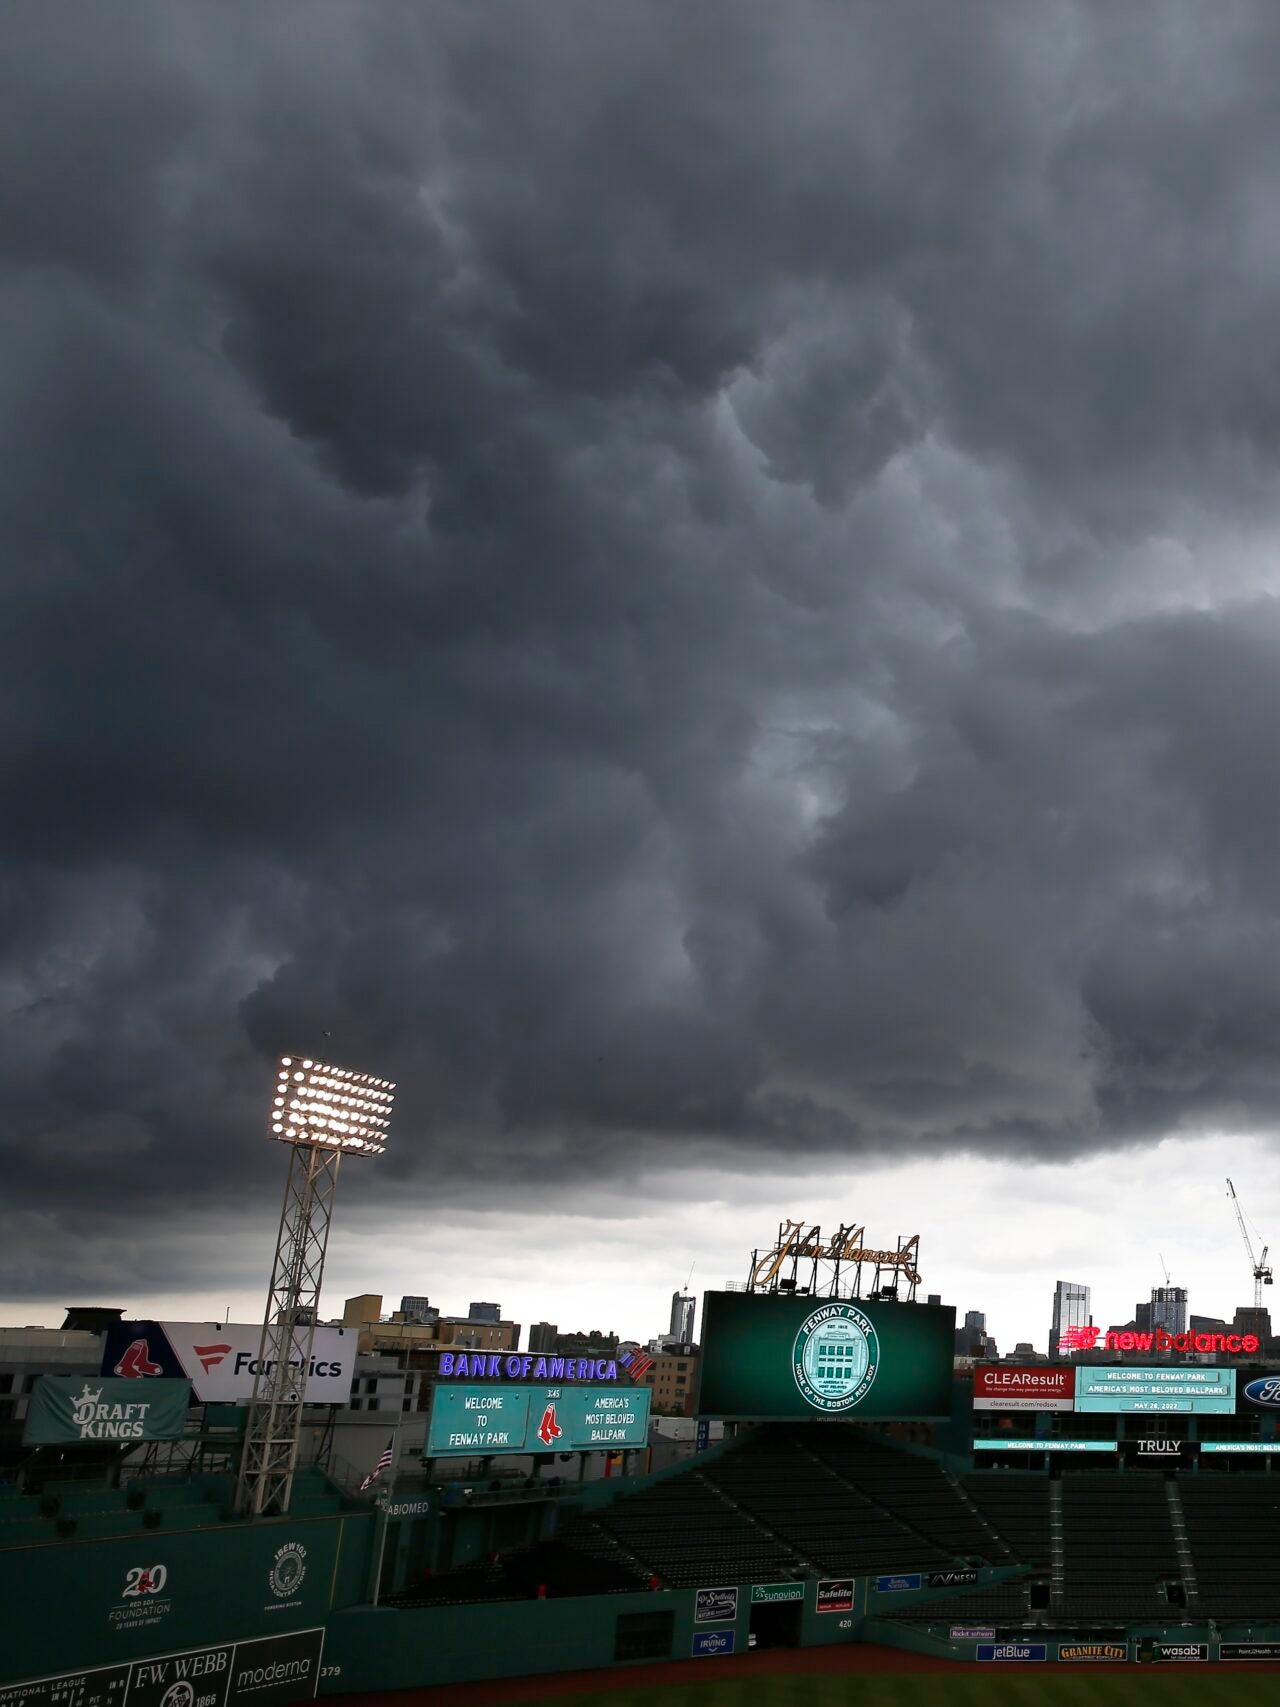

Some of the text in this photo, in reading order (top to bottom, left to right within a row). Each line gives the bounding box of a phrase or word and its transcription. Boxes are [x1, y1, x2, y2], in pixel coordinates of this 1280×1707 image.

[803, 1307, 873, 1337] FENWAY PARK
[1105, 1328, 1260, 1352] new balance
[440, 1353, 617, 1379] BANK OF AMERICA
[984, 1373, 1064, 1385] CLEAResult
[1107, 1372, 1142, 1380] WELCOME
[1144, 1372, 1154, 1380] TO
[795, 1363, 875, 1407] HOME OF THE BOSTON RED SOX
[1088, 1385, 1127, 1393] AMERICA'S
[1186, 1386, 1223, 1394] BALLPARK
[465, 1397, 503, 1409] WELCOME
[595, 1398, 629, 1408] AMERICA'S
[72, 1402, 151, 1425] DRAFT
[585, 1413, 635, 1424] MOST BELOVED
[477, 1415, 487, 1426] TO
[80, 1420, 144, 1438] KINGS
[591, 1430, 626, 1440] BALLPARK
[450, 1432, 508, 1446] FENWAY PARK
[1138, 1440, 1181, 1452] TRULY
[388, 1502, 429, 1515] ABIOMED
[954, 1573, 976, 1584] NESN
[764, 1590, 801, 1600] sunovion
[819, 1588, 852, 1598] Safelite
[108, 1604, 171, 1620] FOUNDATION
[839, 1620, 852, 1628] 420
[700, 1638, 727, 1649] IRVING
[992, 1645, 1031, 1660] jetBlue
[1061, 1646, 1102, 1658] GRANITE
[1161, 1646, 1200, 1656] wasabi
[175, 1652, 227, 1679] WEBB
[320, 1666, 341, 1677] 379
[238, 1659, 312, 1687] moderna
[0, 1677, 86, 1701] NATIONAL LEAGUE
